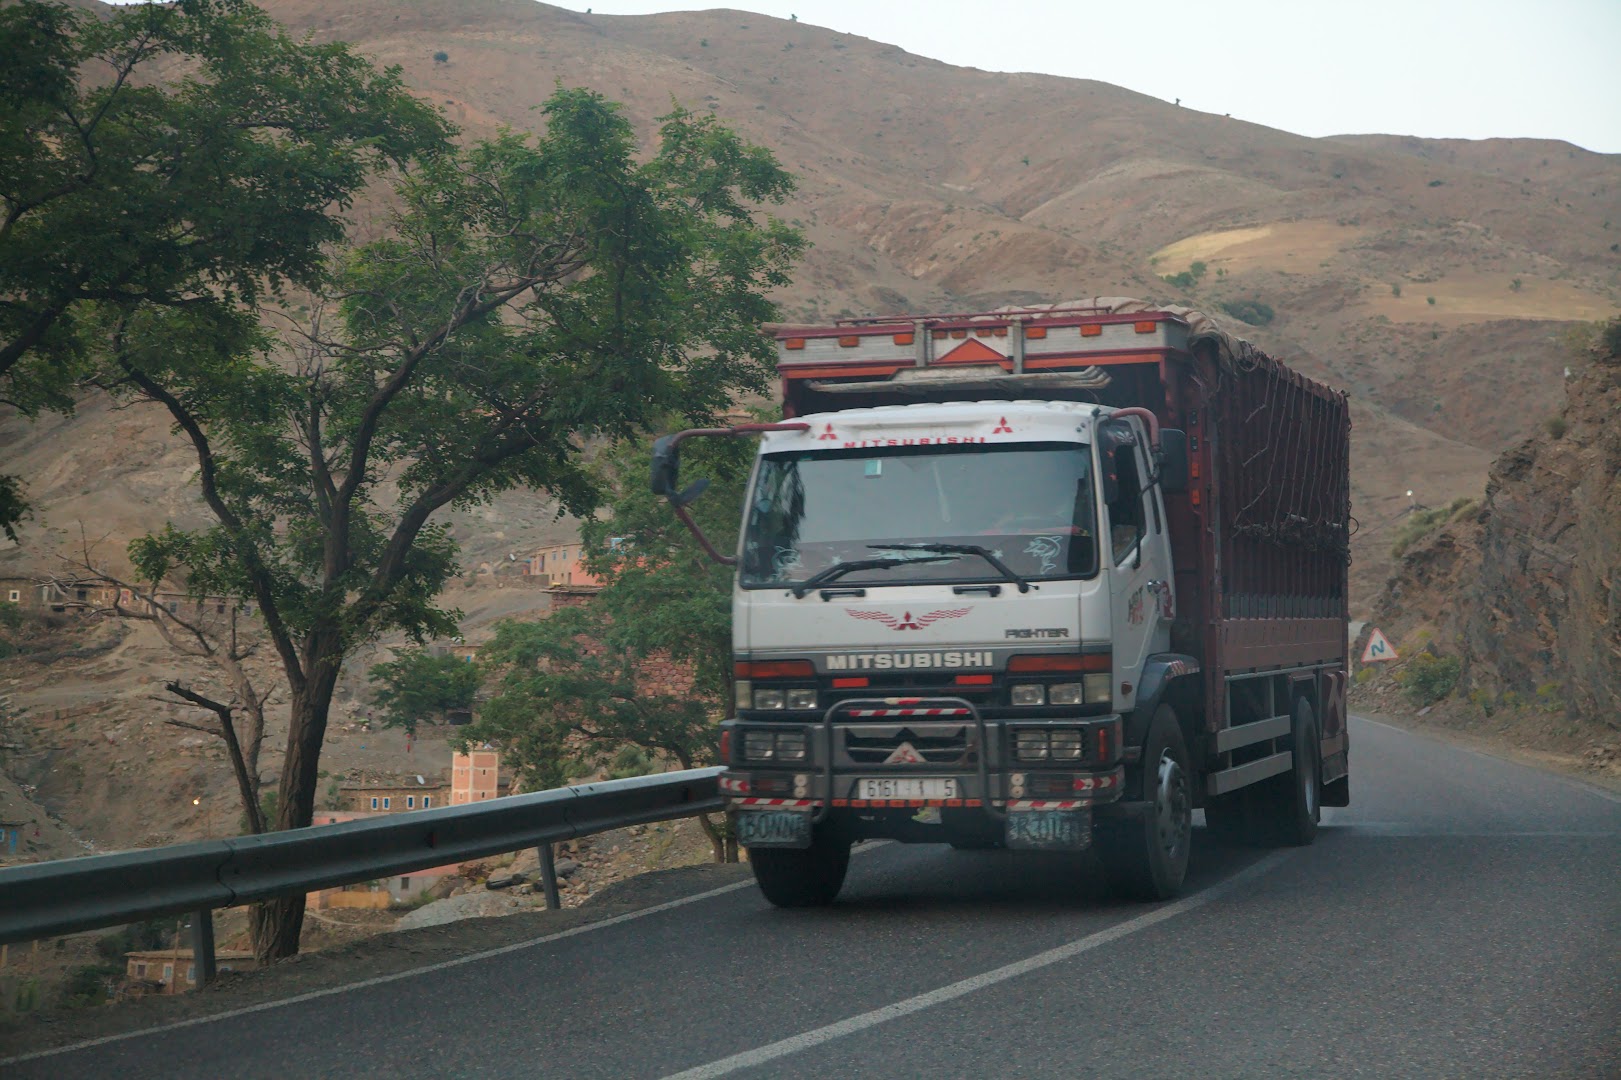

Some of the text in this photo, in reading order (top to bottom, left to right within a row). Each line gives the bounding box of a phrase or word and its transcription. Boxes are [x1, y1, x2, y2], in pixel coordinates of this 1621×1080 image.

[843, 436, 986, 448] MITSUBISHI
[1005, 628, 1069, 639] FIGHTER
[826, 651, 993, 670] MITSUBISHI
[944, 779, 953, 797] 5
